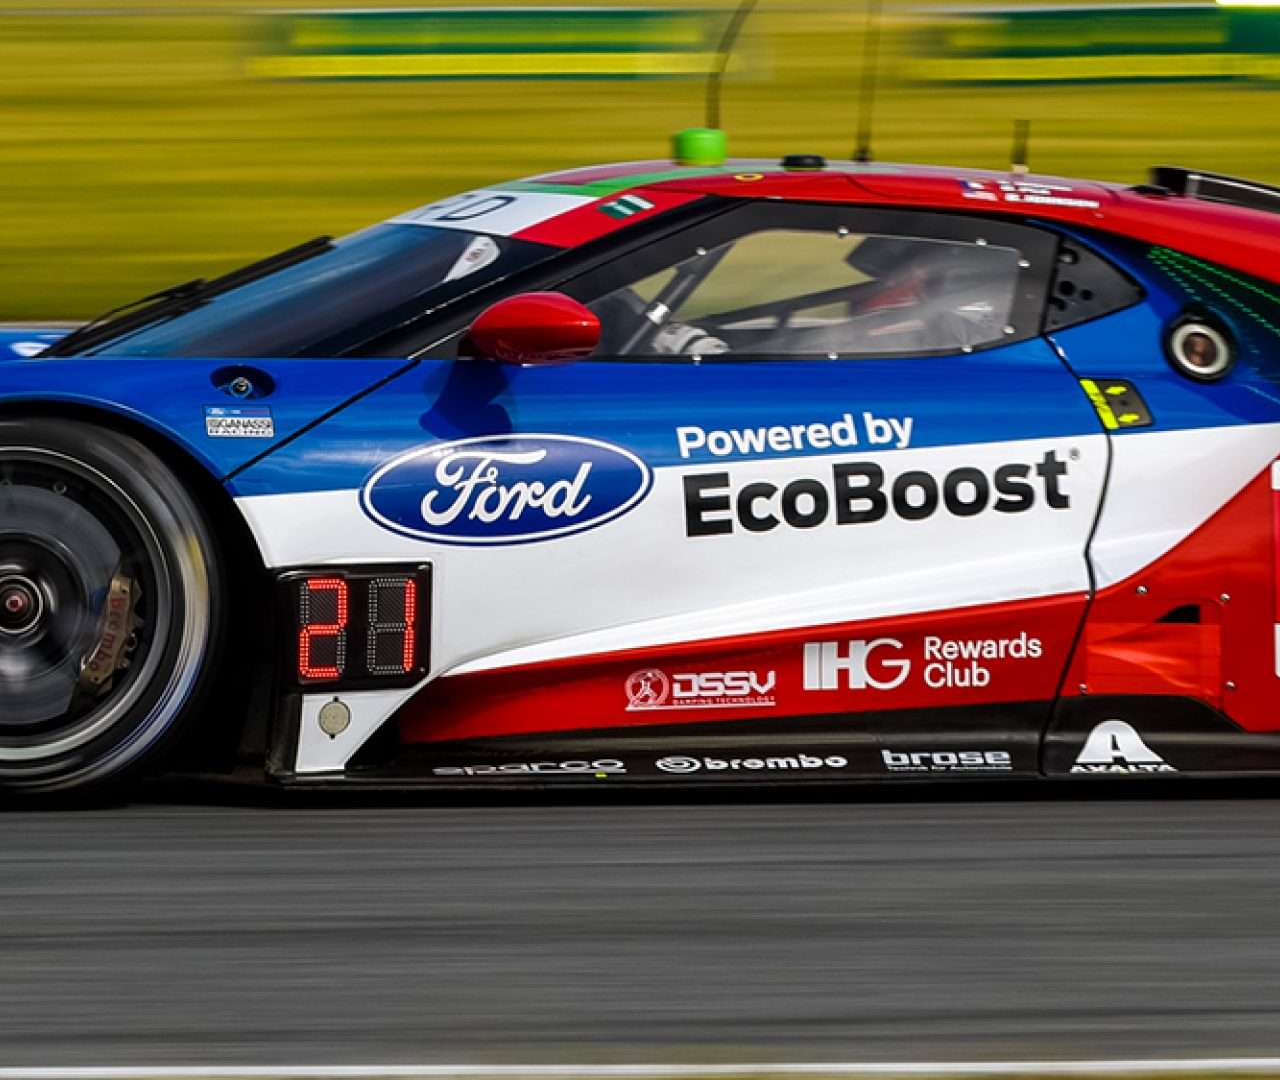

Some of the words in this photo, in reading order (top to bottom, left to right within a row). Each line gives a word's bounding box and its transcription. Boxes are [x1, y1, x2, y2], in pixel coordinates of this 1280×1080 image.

[676, 414, 858, 458] Powered
[863, 412, 913, 449] by
[420, 449, 593, 526] Ford
[682, 449, 1071, 537] EcoBoost
[300, 579, 416, 678] 21
[924, 632, 1042, 660] Rewards
[803, 639, 911, 690] IHG
[924, 661, 990, 688] Club
[672, 670, 776, 697] DSSV
[704, 753, 848, 770] brembo
[881, 749, 1012, 766] brose
